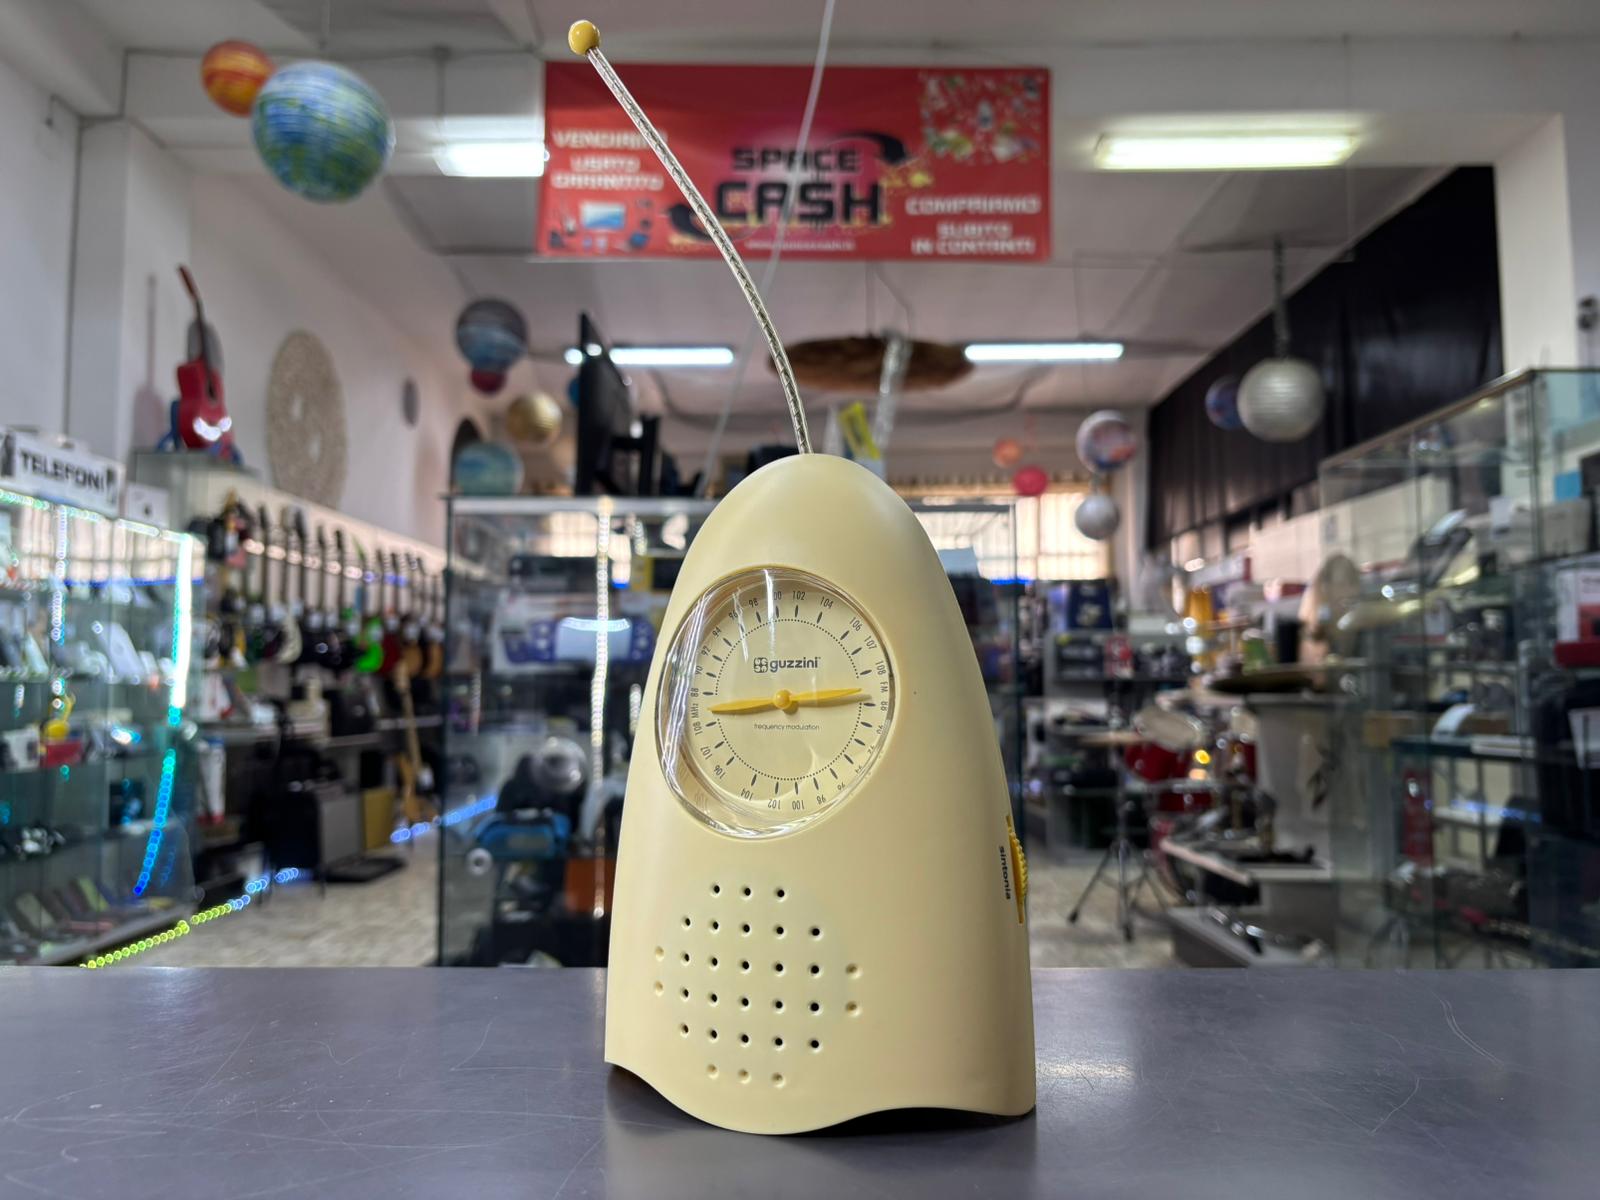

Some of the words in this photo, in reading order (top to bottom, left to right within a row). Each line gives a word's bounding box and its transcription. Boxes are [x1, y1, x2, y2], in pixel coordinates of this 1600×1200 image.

[733, 149, 858, 171] SPACE
[717, 182, 881, 224] CASH
[748, 597, 759, 608] 98
[792, 590, 806, 601] 102
[819, 596, 834, 610] 104
[849, 616, 863, 632] 106
[711, 625, 723, 638] 94
[863, 635, 878, 650] 107
[700, 645, 712, 657] 92
[769, 656, 819, 674] guzzini
[875, 660, 887, 676] 108
[690, 687, 700, 698] 88
[879, 680, 889, 694] FM
[690, 703, 699, 719] MHz
[880, 700, 889, 712] 88
[692, 721, 703, 736] 108
[754, 723, 785, 731] frequency
[786, 722, 820, 730] modulation
[700, 746, 713, 760] 107
[713, 764, 726, 779] 106
[740, 787, 754, 801] 104
[816, 794, 827, 805] 98
[767, 799, 781, 810] 102
[792, 799, 805, 810] 100
[999, 845, 1011, 900] sintonia
